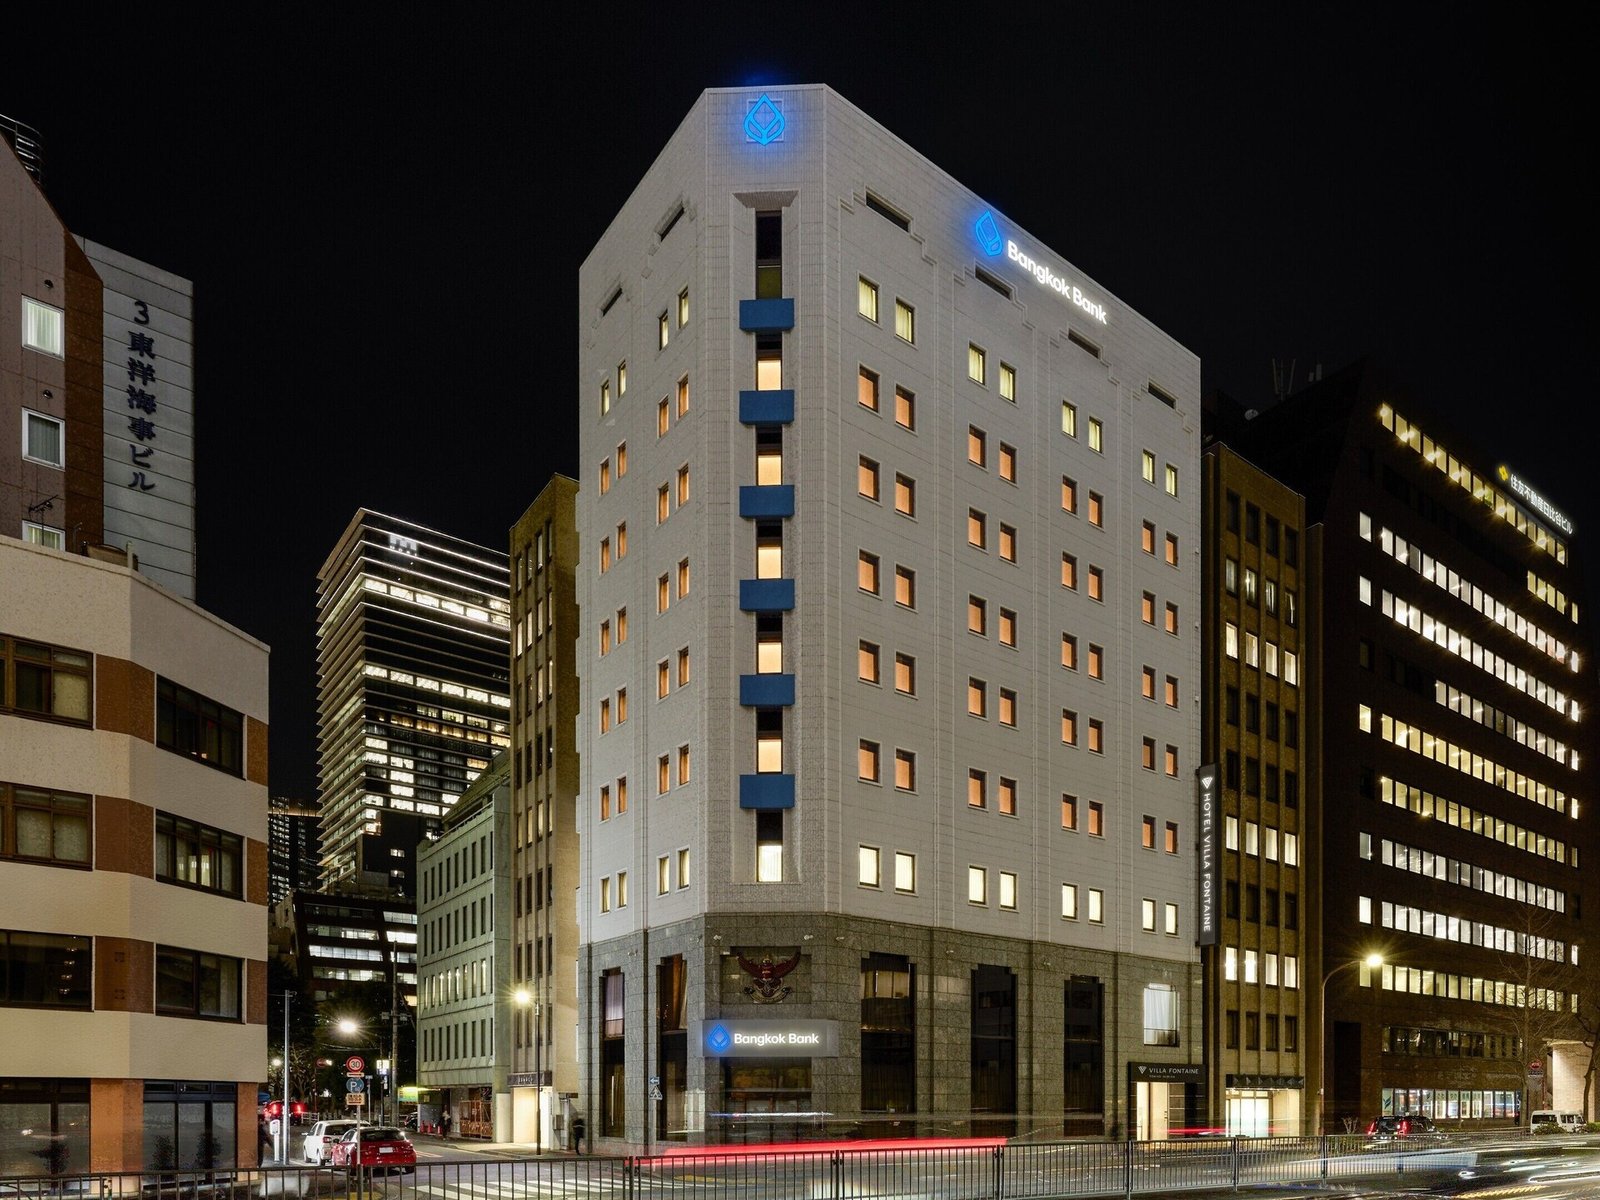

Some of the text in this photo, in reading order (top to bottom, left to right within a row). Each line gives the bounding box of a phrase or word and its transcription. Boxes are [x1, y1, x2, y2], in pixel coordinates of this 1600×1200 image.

[1007, 239, 1107, 325] Bangkok Bank
[127, 300, 156, 491] 3東洋海事ビル
[1510, 474, 1573, 535] 住友不動産日比谷ビル
[1203, 793, 1211, 932] HOTEL VILLA FONTAINE
[351, 1060, 361, 1068] 30
[734, 1033, 819, 1046] Bangkok Bank
